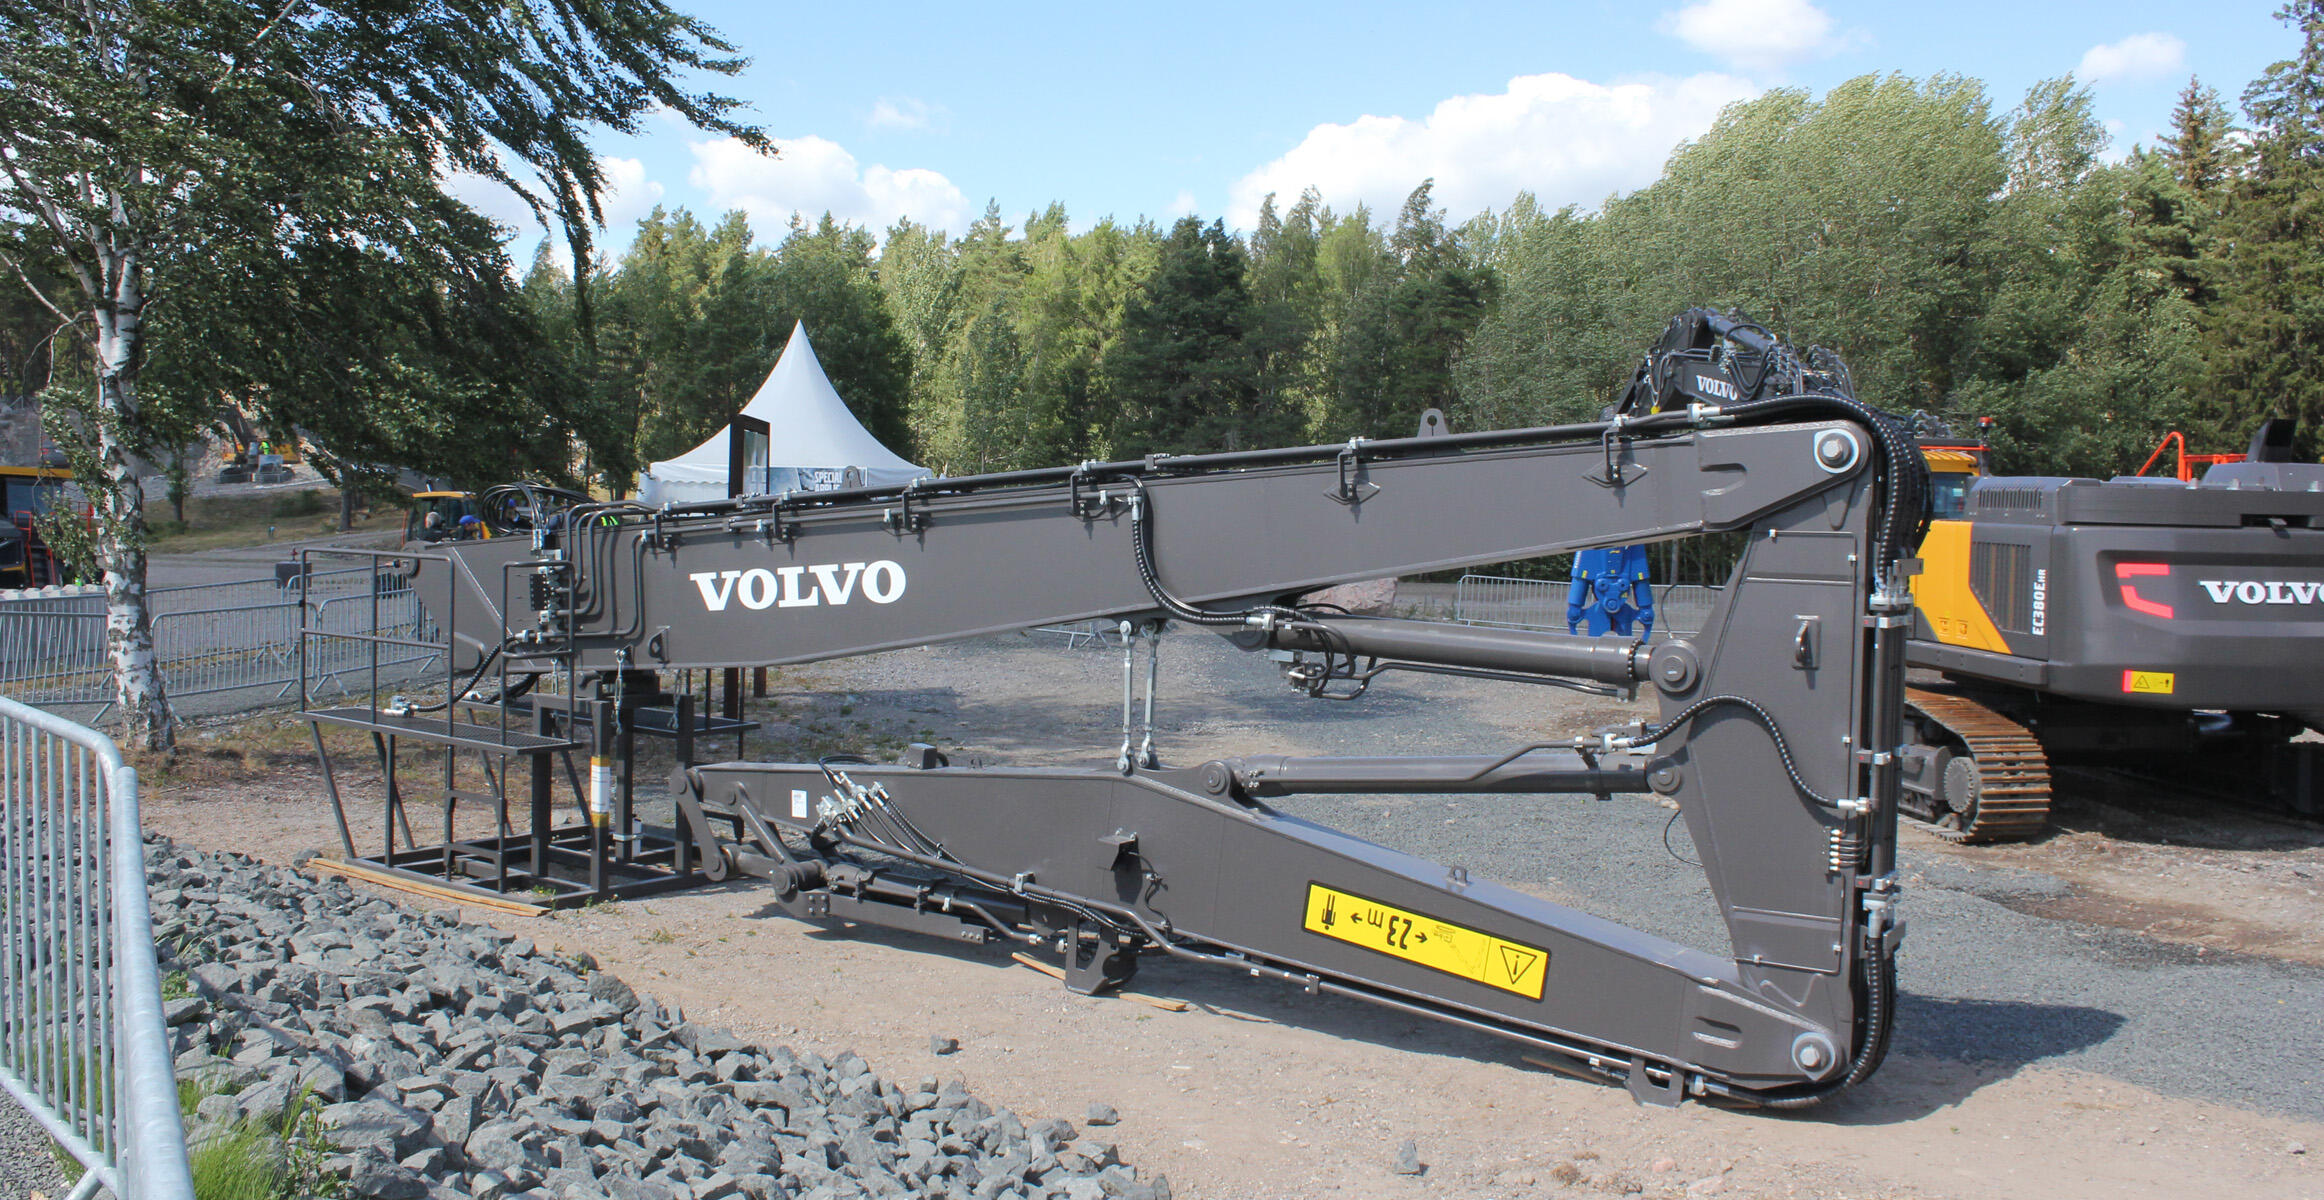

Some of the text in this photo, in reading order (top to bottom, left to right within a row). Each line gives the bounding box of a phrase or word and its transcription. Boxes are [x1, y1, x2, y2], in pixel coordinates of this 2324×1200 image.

[1695, 374, 1738, 401] VOLVO
[689, 559, 907, 611] VOLVO
[2199, 580, 2324, 605] VOLV
[1386, 914, 1413, 951] 23
